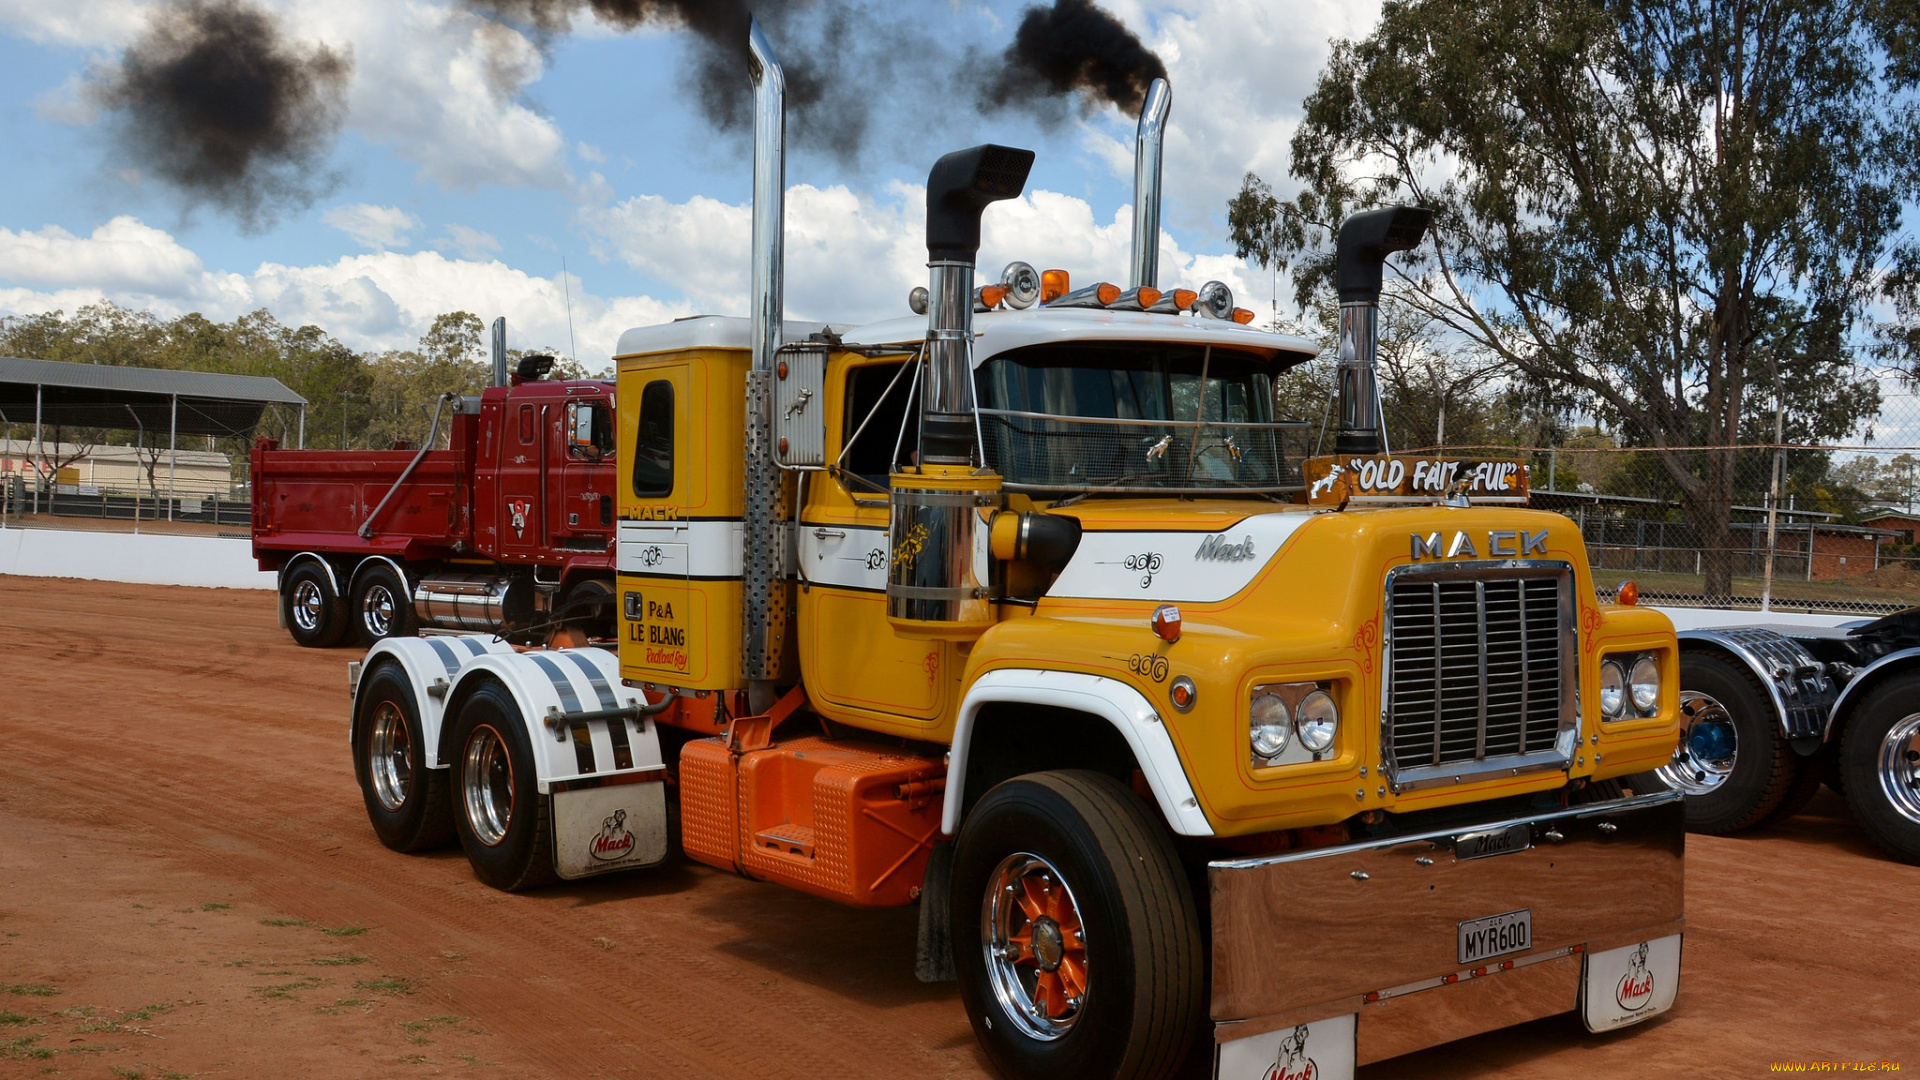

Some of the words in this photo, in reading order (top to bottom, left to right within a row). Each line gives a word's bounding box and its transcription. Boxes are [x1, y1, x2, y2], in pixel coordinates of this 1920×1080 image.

[1413, 459, 1518, 491] FAITFUL"
[629, 505, 678, 521] MACK
[1195, 533, 1257, 561] Mack
[1410, 528, 1549, 560] MACK
[648, 600, 674, 620] P&A
[630, 622, 645, 642] LE
[650, 624, 685, 647] BLANG
[646, 647, 675, 665] Redland
[593, 833, 632, 854] Mack
[1474, 832, 1512, 854] Mack
[1465, 921, 1526, 959] MYR600
[1620, 974, 1651, 1002] Mack
